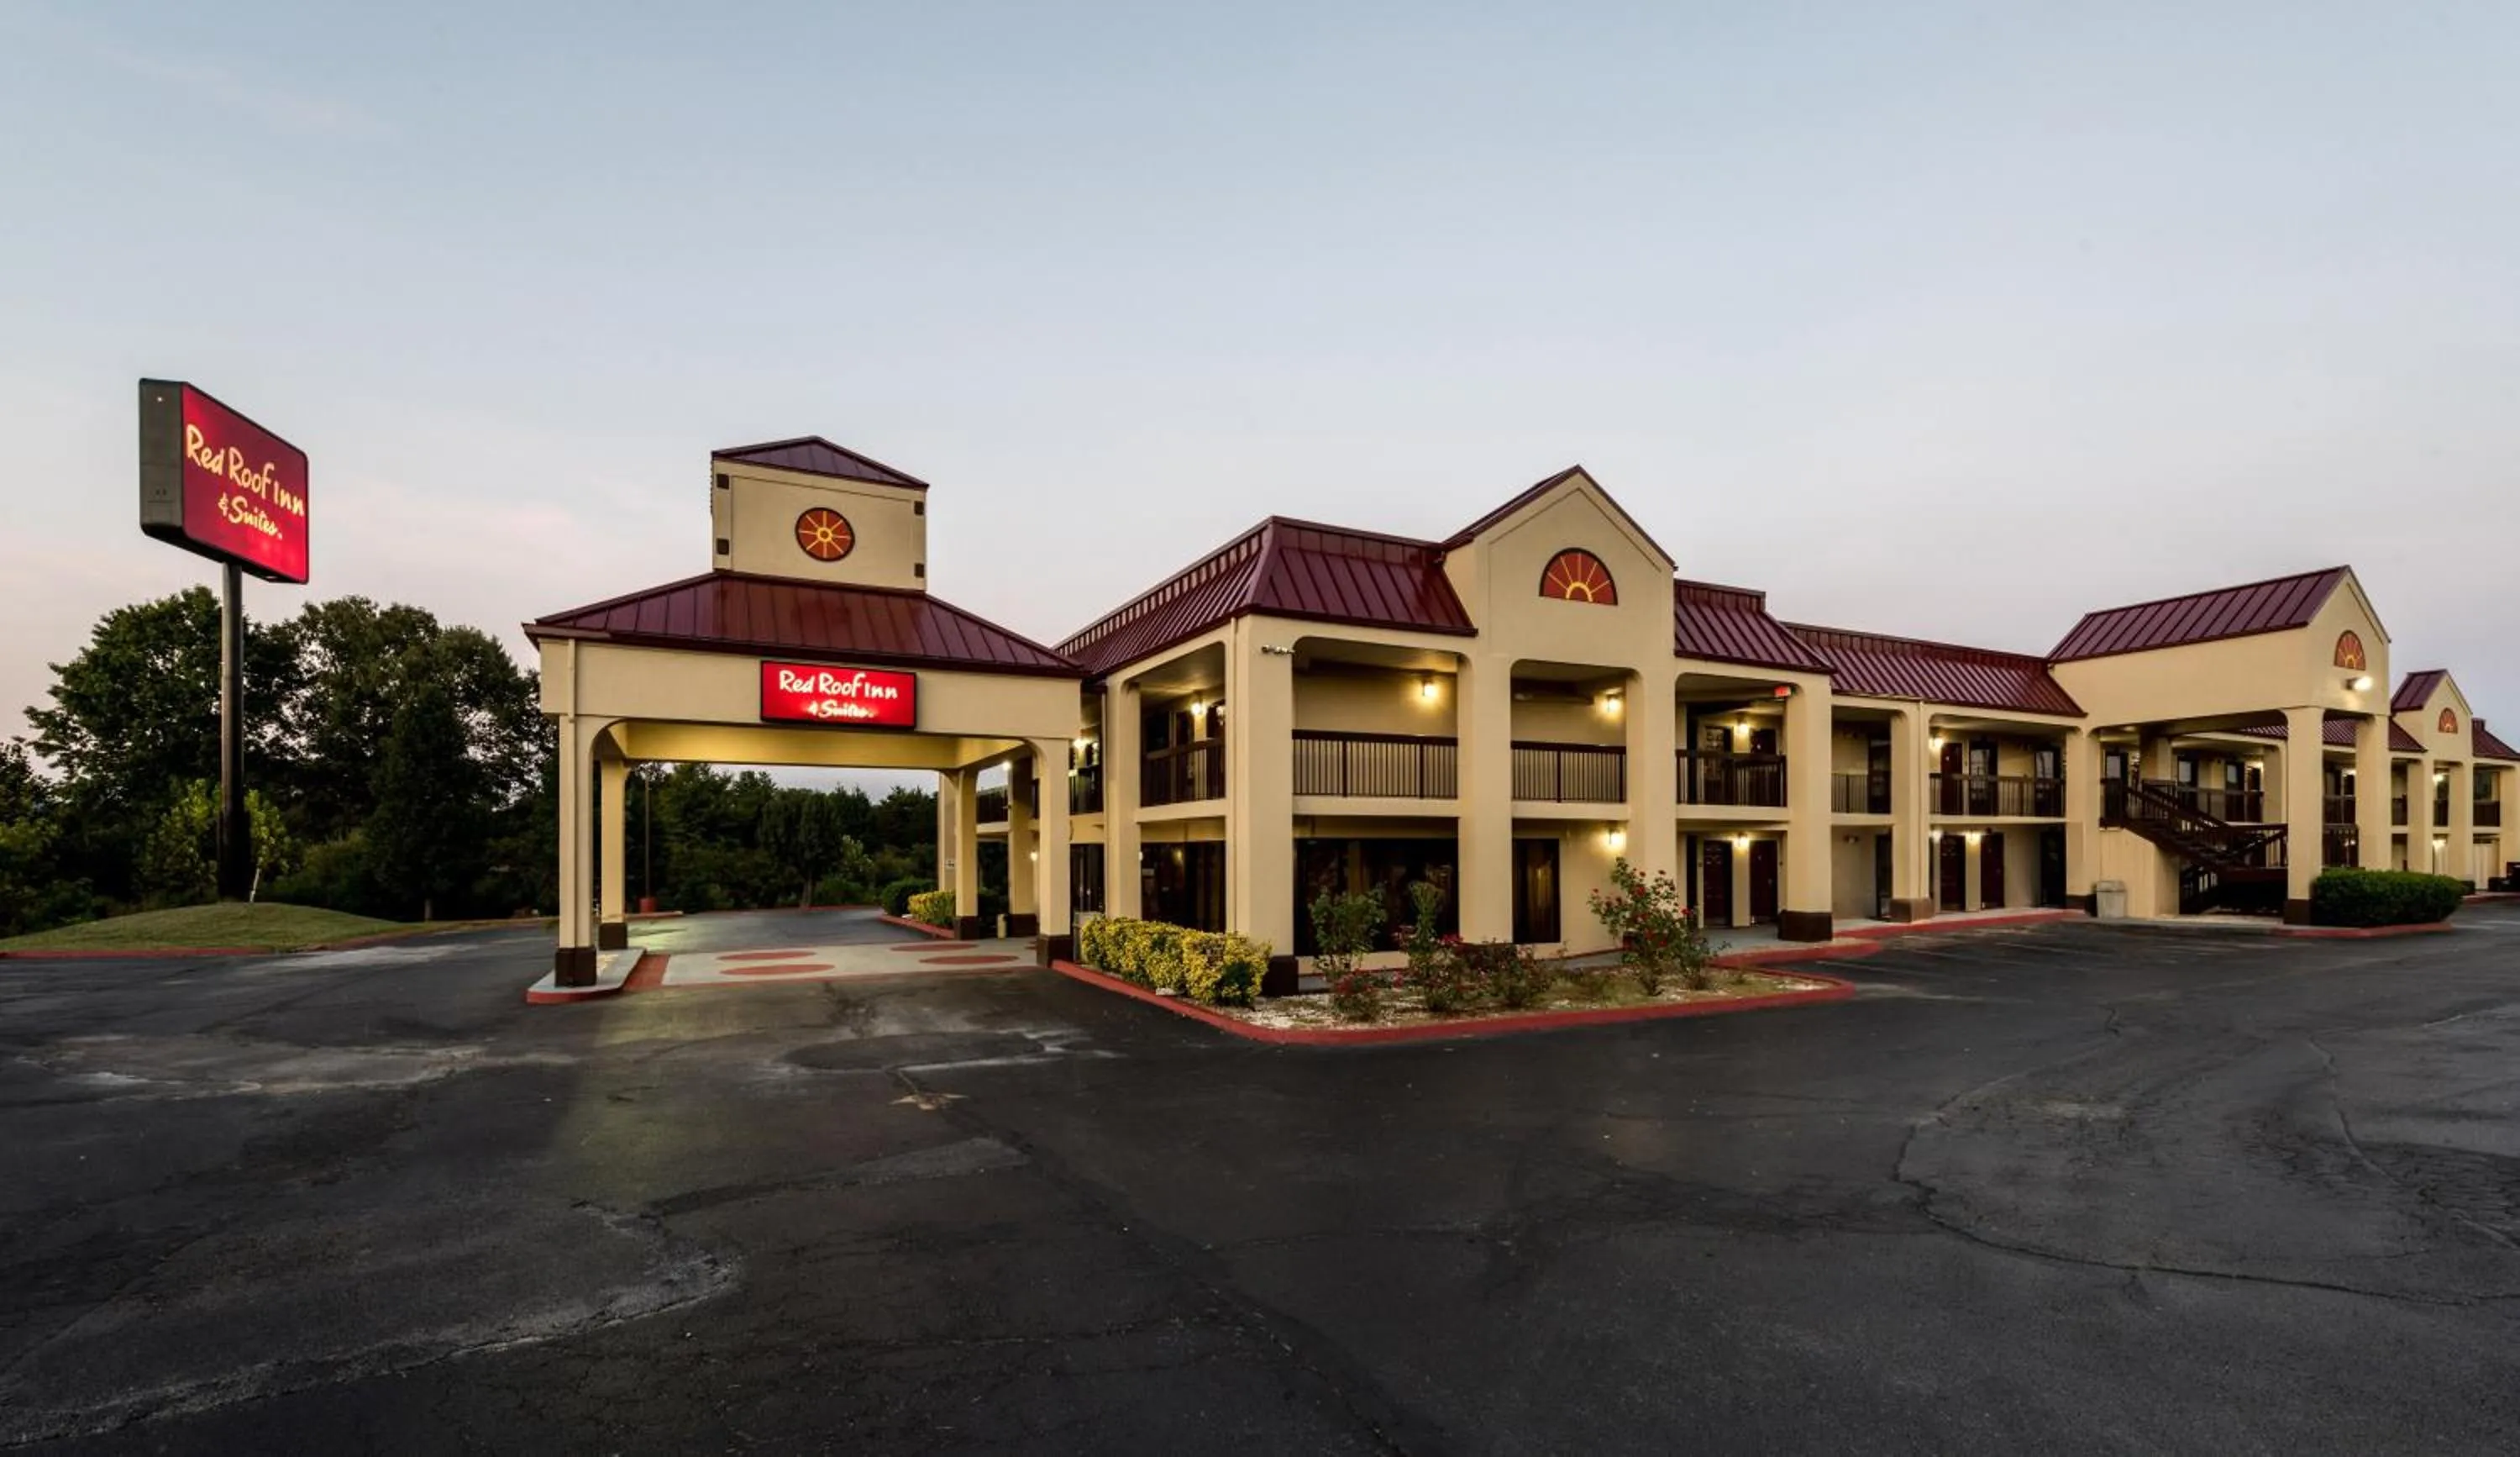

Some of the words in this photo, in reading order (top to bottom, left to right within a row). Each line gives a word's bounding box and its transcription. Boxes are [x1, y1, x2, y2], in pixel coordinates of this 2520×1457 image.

[186, 423, 225, 476] Red
[228, 446, 274, 499] Roof
[274, 482, 305, 518] Inn
[779, 670, 816, 693] Red
[819, 672, 866, 697] Roof
[864, 682, 898, 699] Inn
